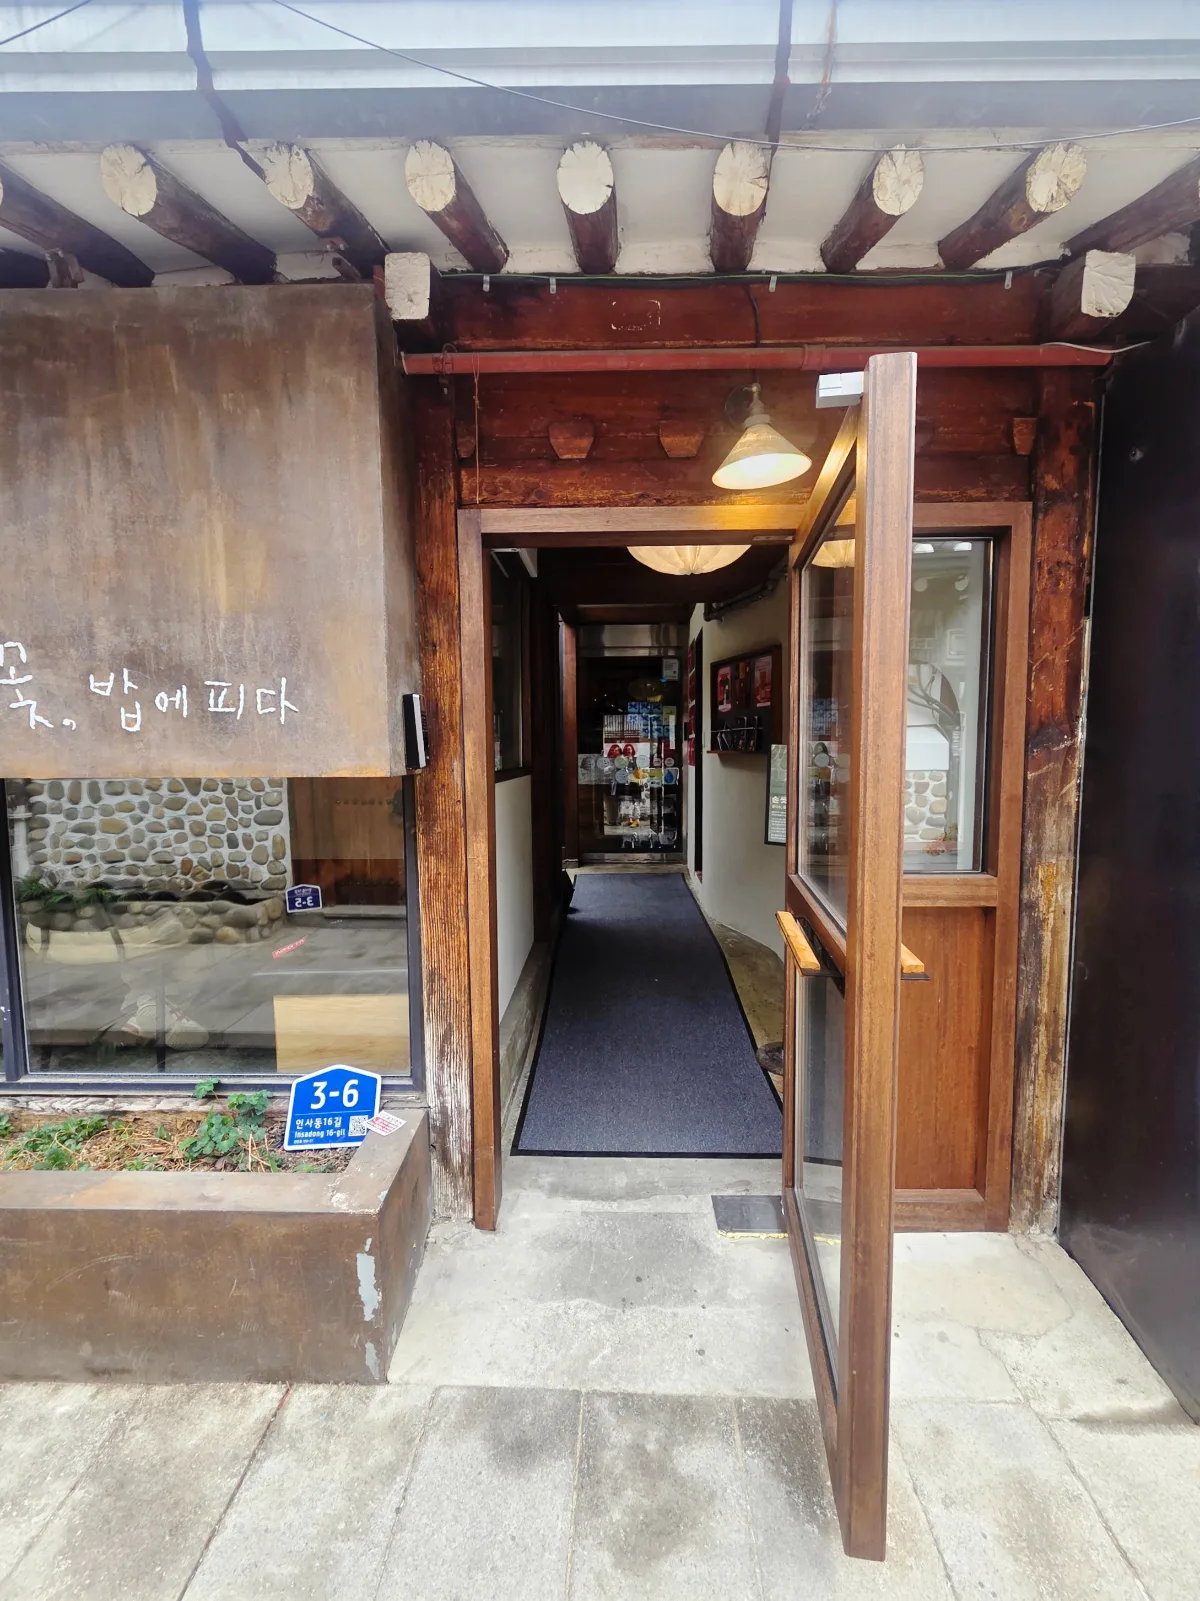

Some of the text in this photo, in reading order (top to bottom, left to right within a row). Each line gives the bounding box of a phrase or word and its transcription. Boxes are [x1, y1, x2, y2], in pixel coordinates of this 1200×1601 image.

[310, 1079, 359, 1109] 3-6
[295, 1117, 342, 1130] 인사동16길
[294, 1128, 346, 1139] Insadong 16-gil
